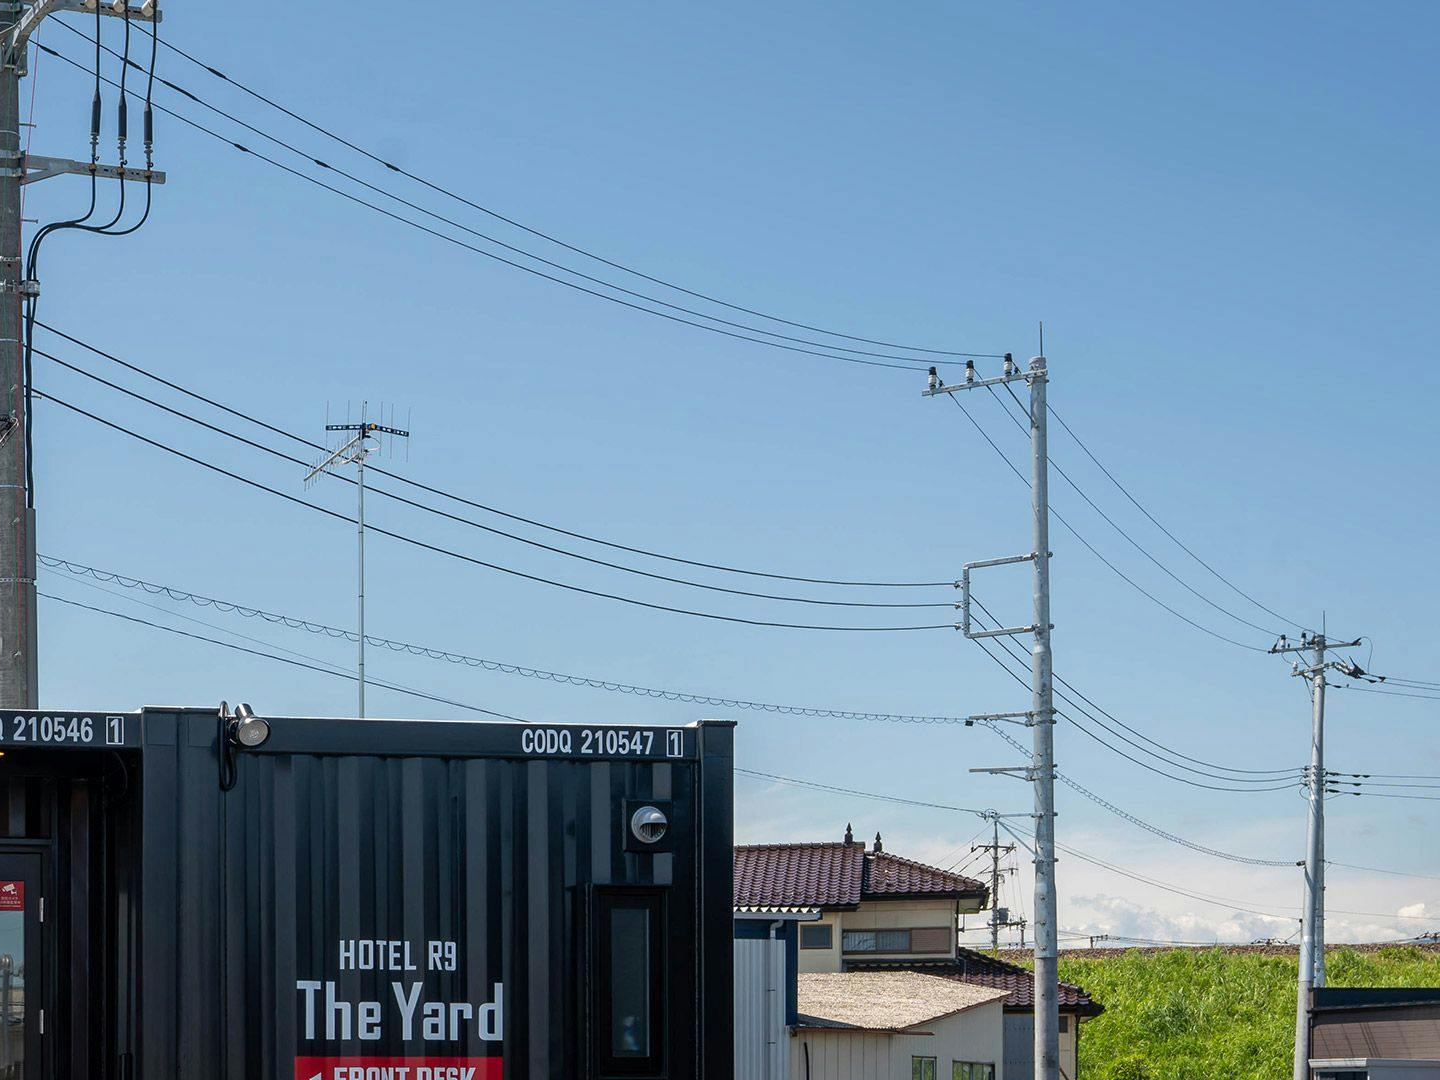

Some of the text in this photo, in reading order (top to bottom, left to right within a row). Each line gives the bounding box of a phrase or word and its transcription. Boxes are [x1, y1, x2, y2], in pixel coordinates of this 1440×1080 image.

[13, 716, 93, 742] 210546
[521, 728, 572, 755] CODQ
[580, 730, 654, 756] 210547
[340, 940, 457, 972] HOTEL R9
[296, 980, 504, 1041] The Yard
